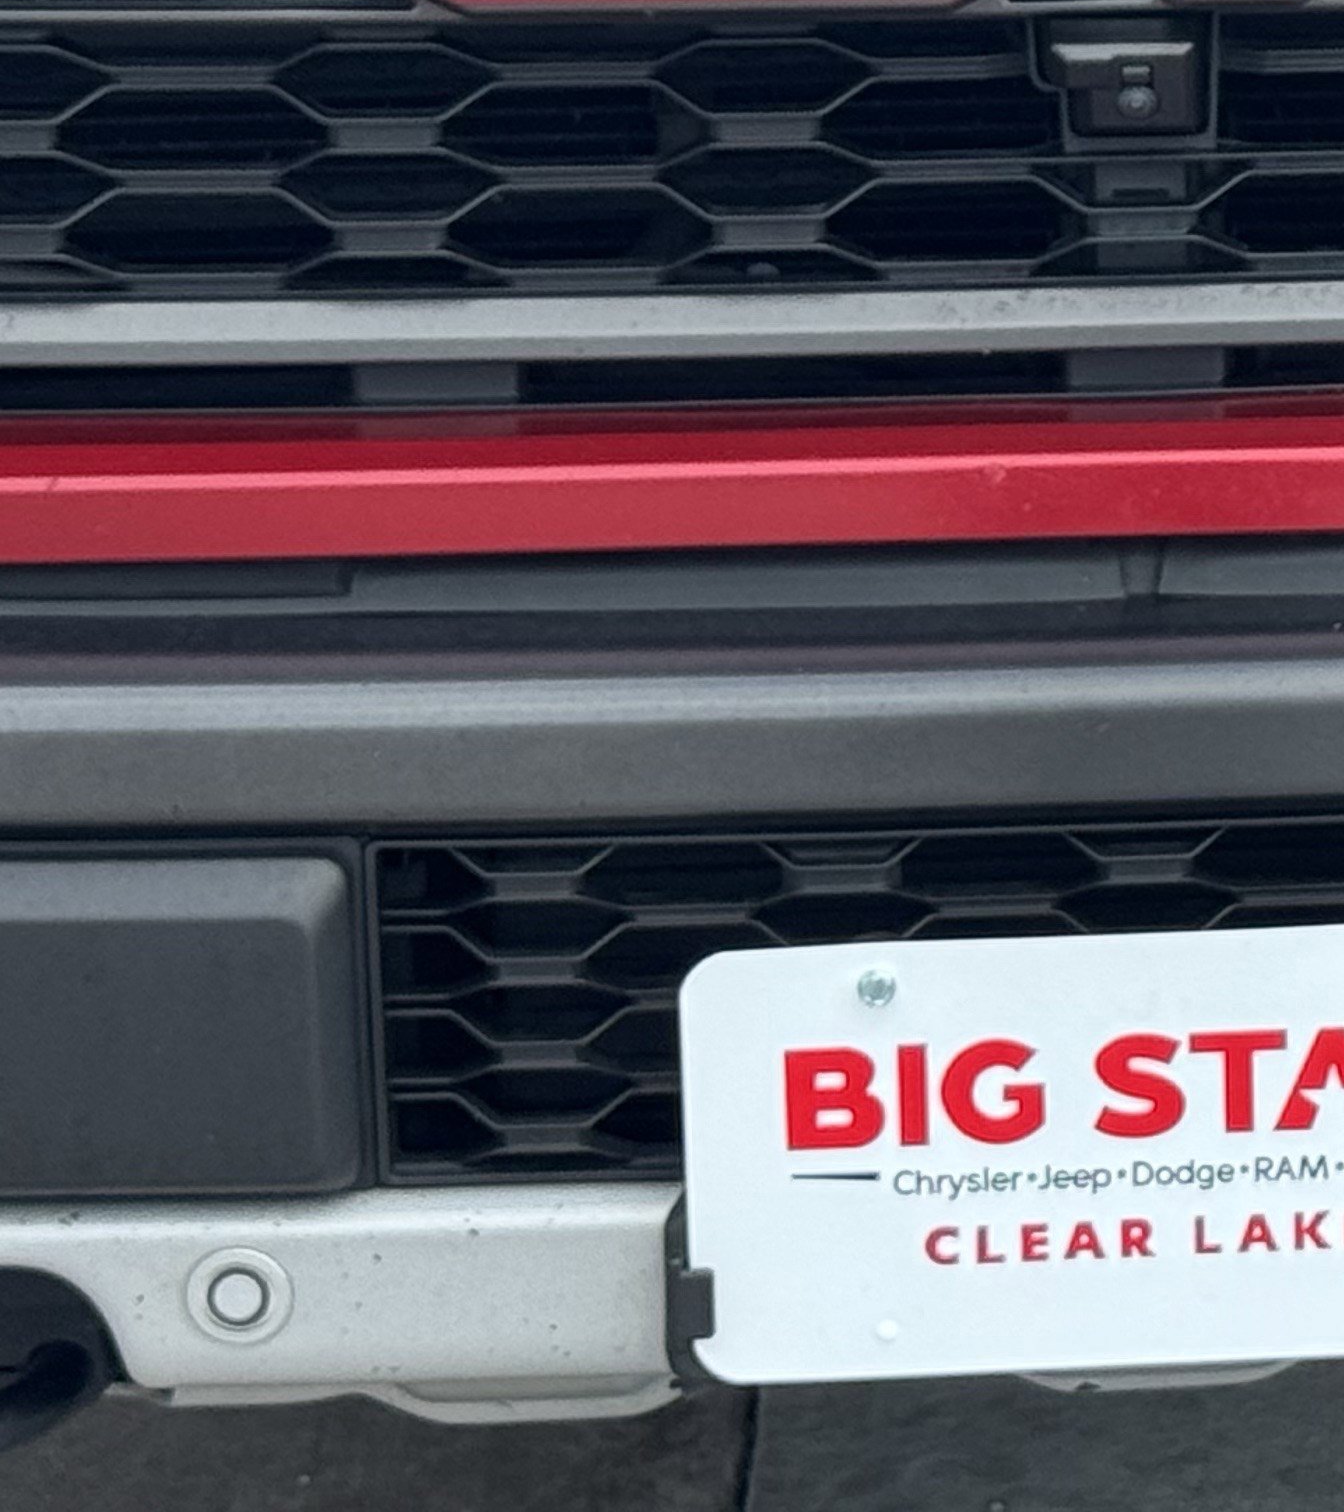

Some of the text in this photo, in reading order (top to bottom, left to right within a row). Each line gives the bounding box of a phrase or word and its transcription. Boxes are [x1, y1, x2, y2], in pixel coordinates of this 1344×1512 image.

[782, 1037, 1047, 1152] BIG
[892, 1166, 1024, 1201] Chrysler
[1037, 1162, 1113, 1195] Jeep
[1131, 1159, 1236, 1192] Dodge
[1253, 1154, 1330, 1183] RAM
[923, 1218, 1157, 1267] CLEAR
